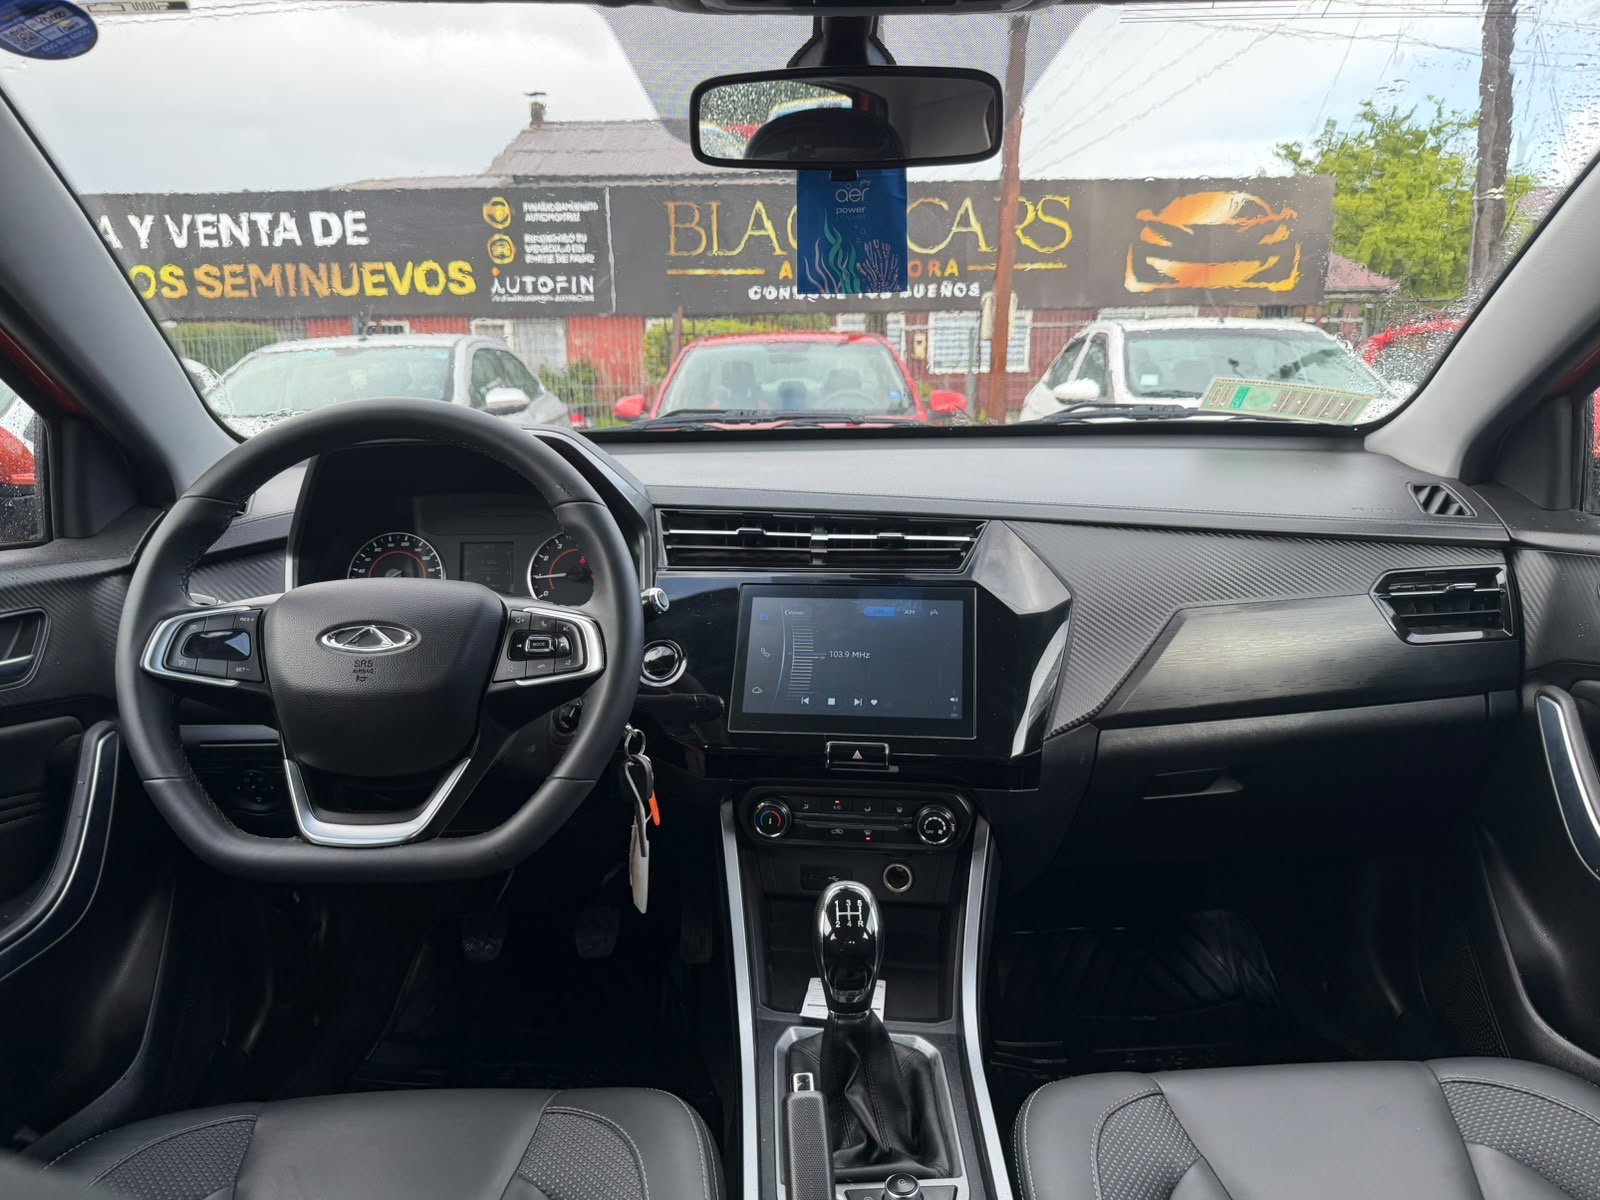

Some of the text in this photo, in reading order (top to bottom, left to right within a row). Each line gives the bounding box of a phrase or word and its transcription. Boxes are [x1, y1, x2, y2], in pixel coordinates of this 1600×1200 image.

[836, 206, 867, 217] power
[127, 214, 155, 249] Y
[163, 211, 302, 248] VENTA
[309, 210, 370, 247] DE
[193, 260, 477, 299] SEMINUEVOS
[490, 274, 595, 294] AUTOFIN
[829, 650, 850, 659] 103.9
[851, 651, 871, 659] MHz
[353, 659, 374, 668] SRS
